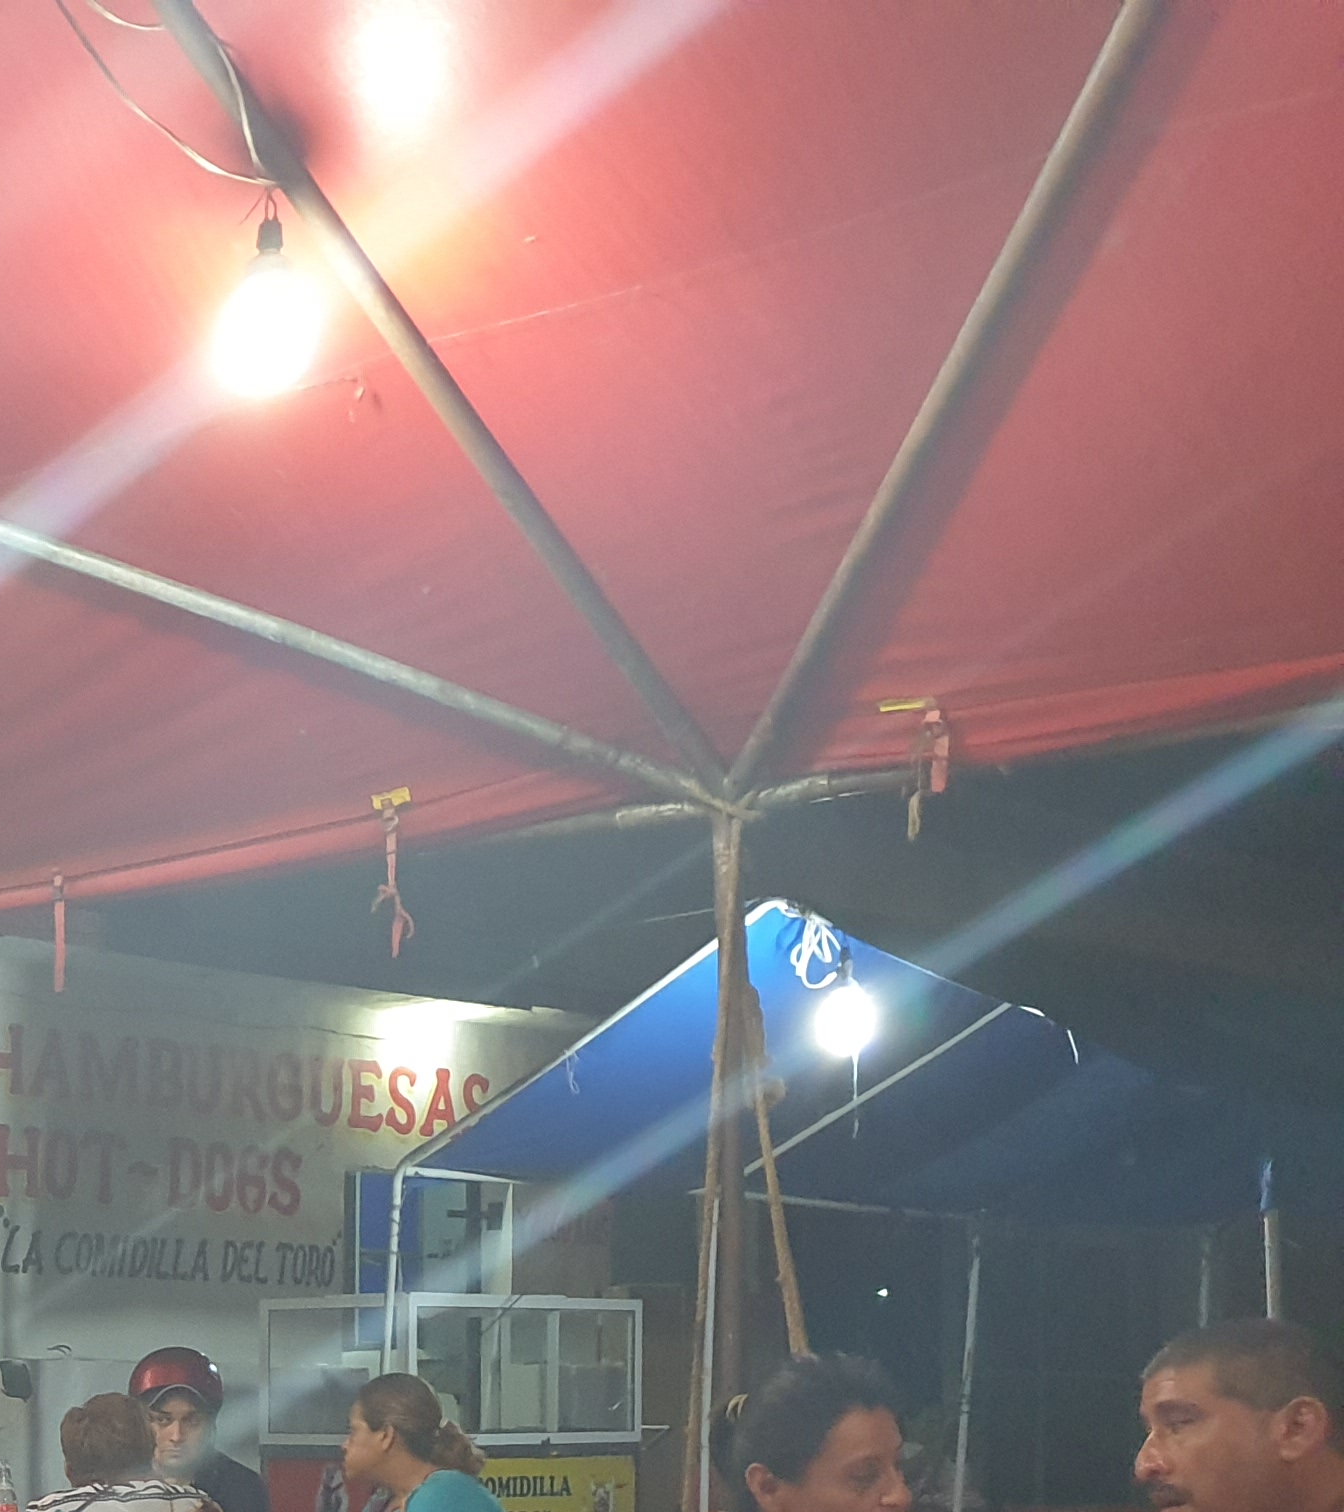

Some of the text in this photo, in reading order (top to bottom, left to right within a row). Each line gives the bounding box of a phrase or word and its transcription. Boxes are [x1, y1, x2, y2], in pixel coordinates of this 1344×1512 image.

[53, 1231, 211, 1283] COMIDILLA
[220, 1239, 268, 1286] DEL
[478, 1475, 573, 1498] OMIDILLA
